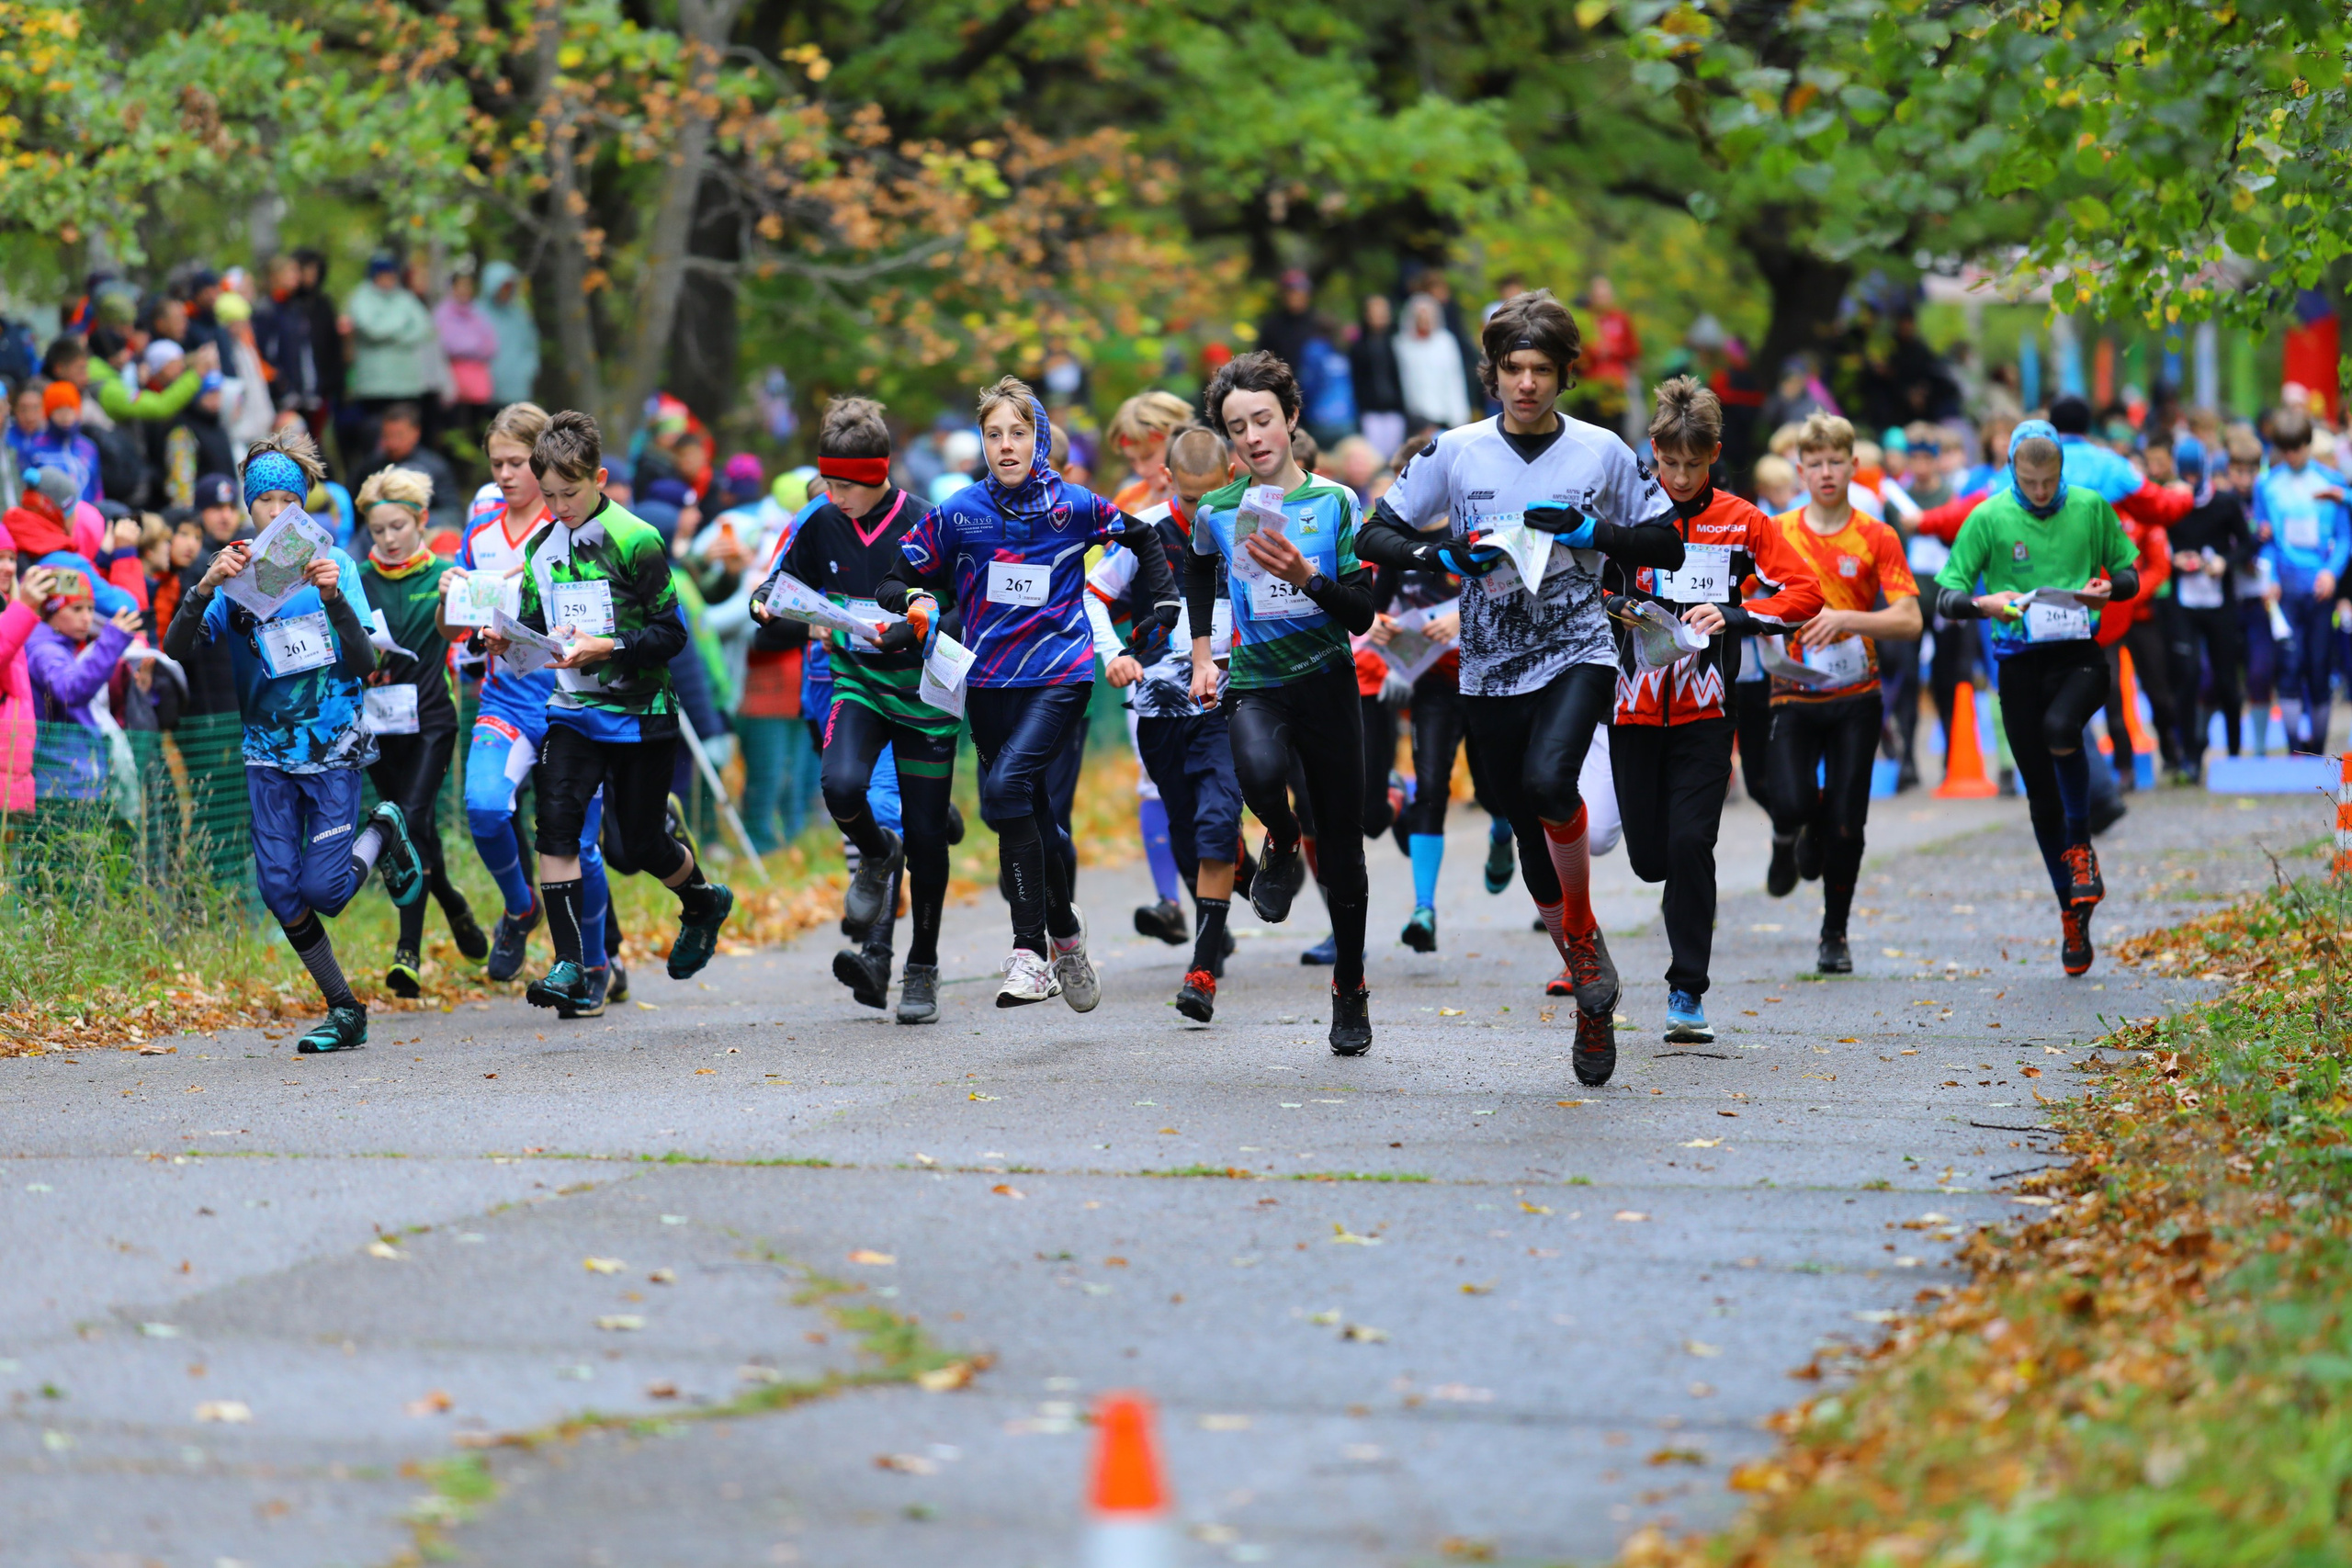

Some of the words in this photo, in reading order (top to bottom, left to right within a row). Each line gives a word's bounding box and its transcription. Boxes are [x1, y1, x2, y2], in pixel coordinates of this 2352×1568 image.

[1696, 524, 1747, 534] МОСКВА
[1005, 578, 1033, 592] 267
[1690, 576, 1713, 590] 249
[563, 603, 587, 617] 259
[2046, 609, 2067, 623] 264
[284, 639, 308, 657] 261
[313, 823, 351, 843] noname
